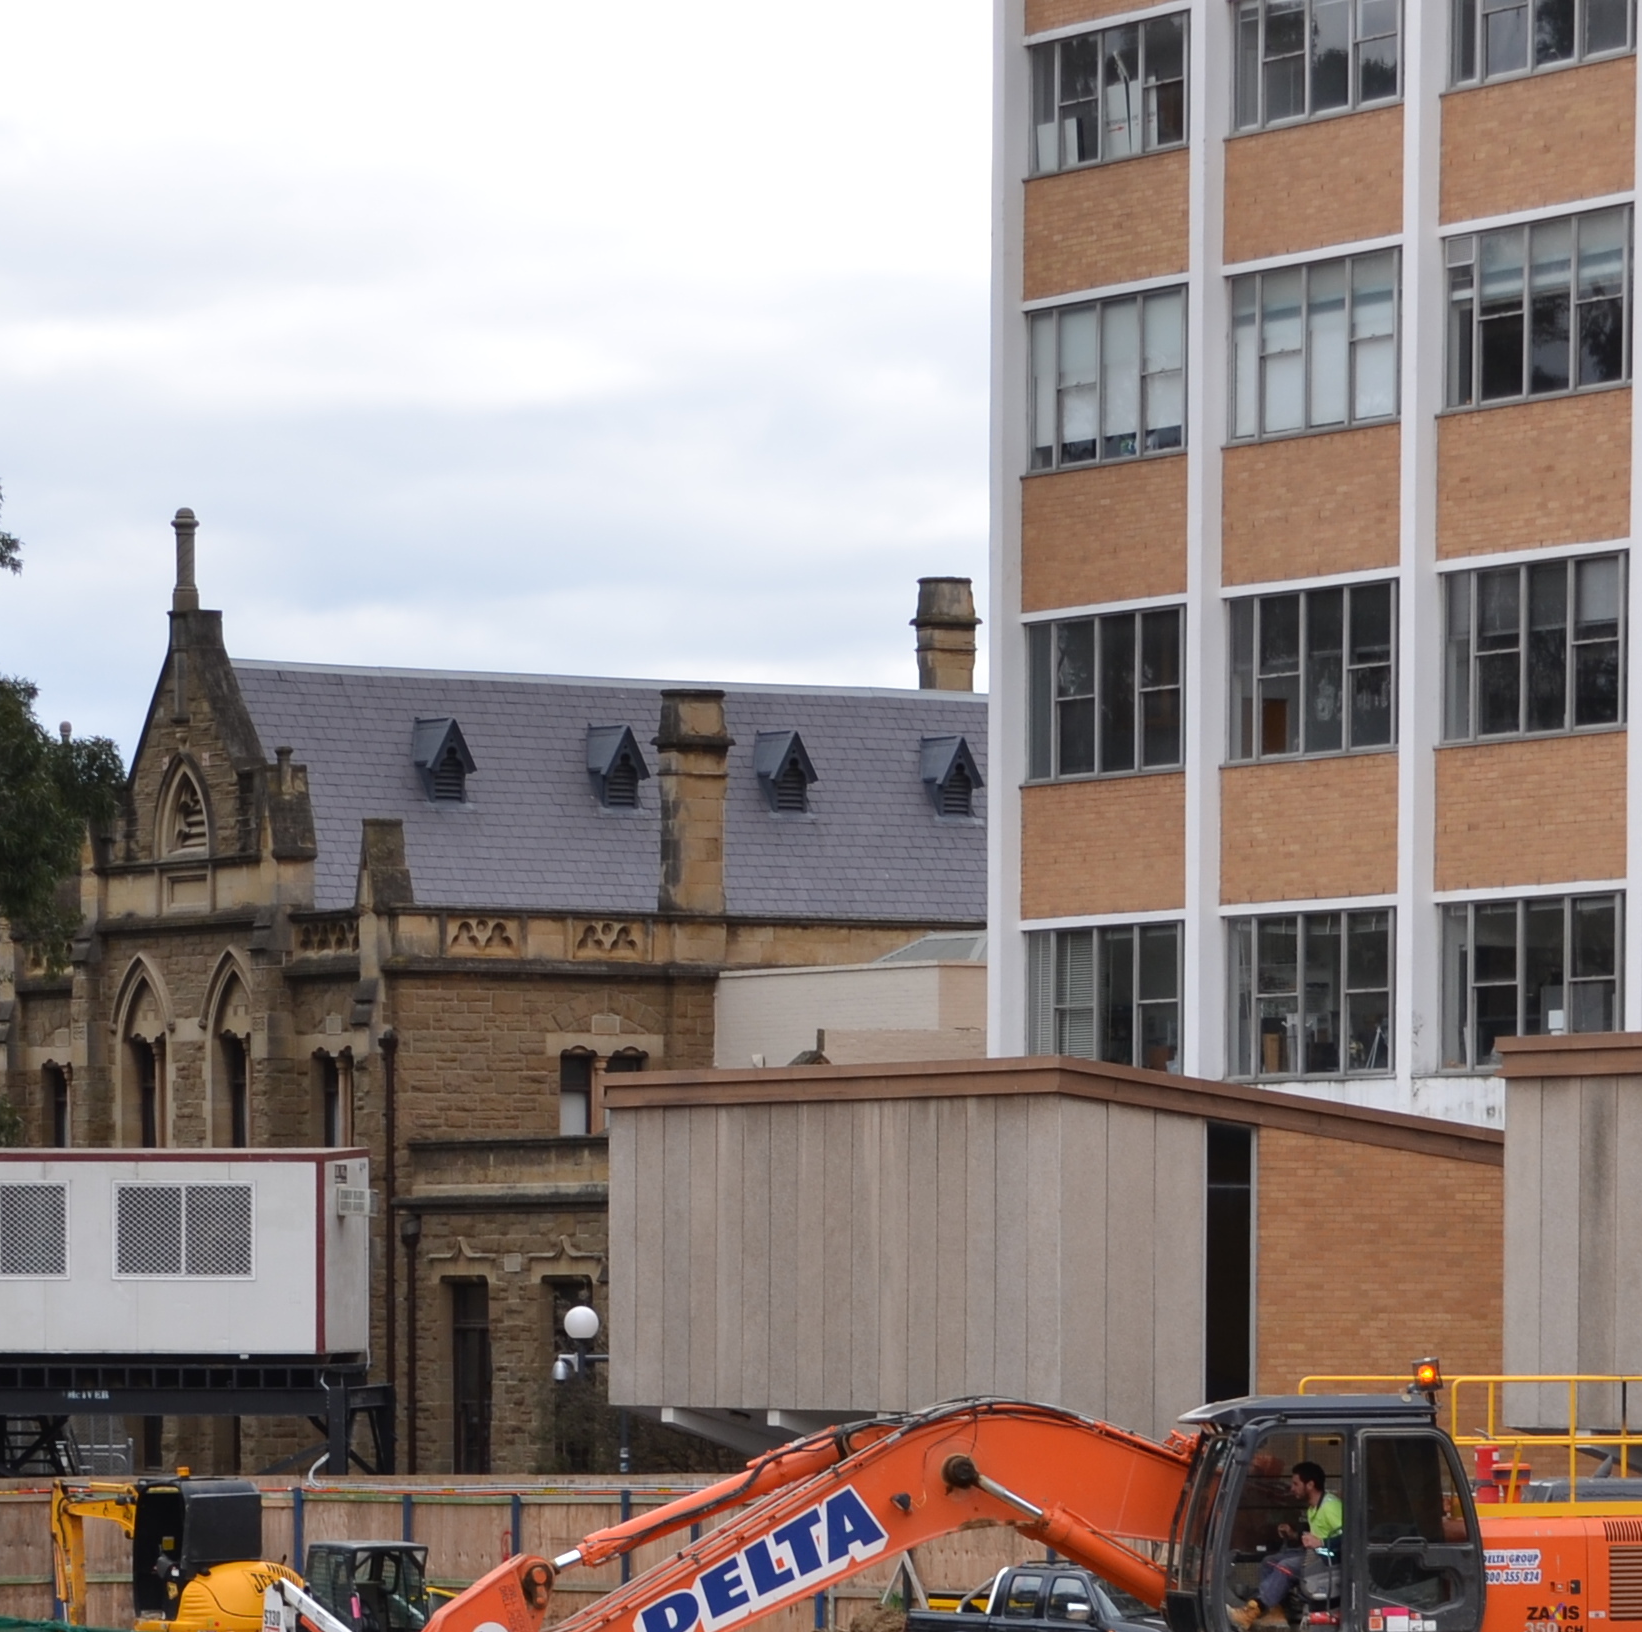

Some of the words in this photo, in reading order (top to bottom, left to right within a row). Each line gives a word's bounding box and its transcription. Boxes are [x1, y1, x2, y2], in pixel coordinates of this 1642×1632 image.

[1508, 1553, 1539, 1563] GROUP
[1503, 1571, 1520, 1582] 355
[1526, 1602, 1580, 1621] ZAXIS
